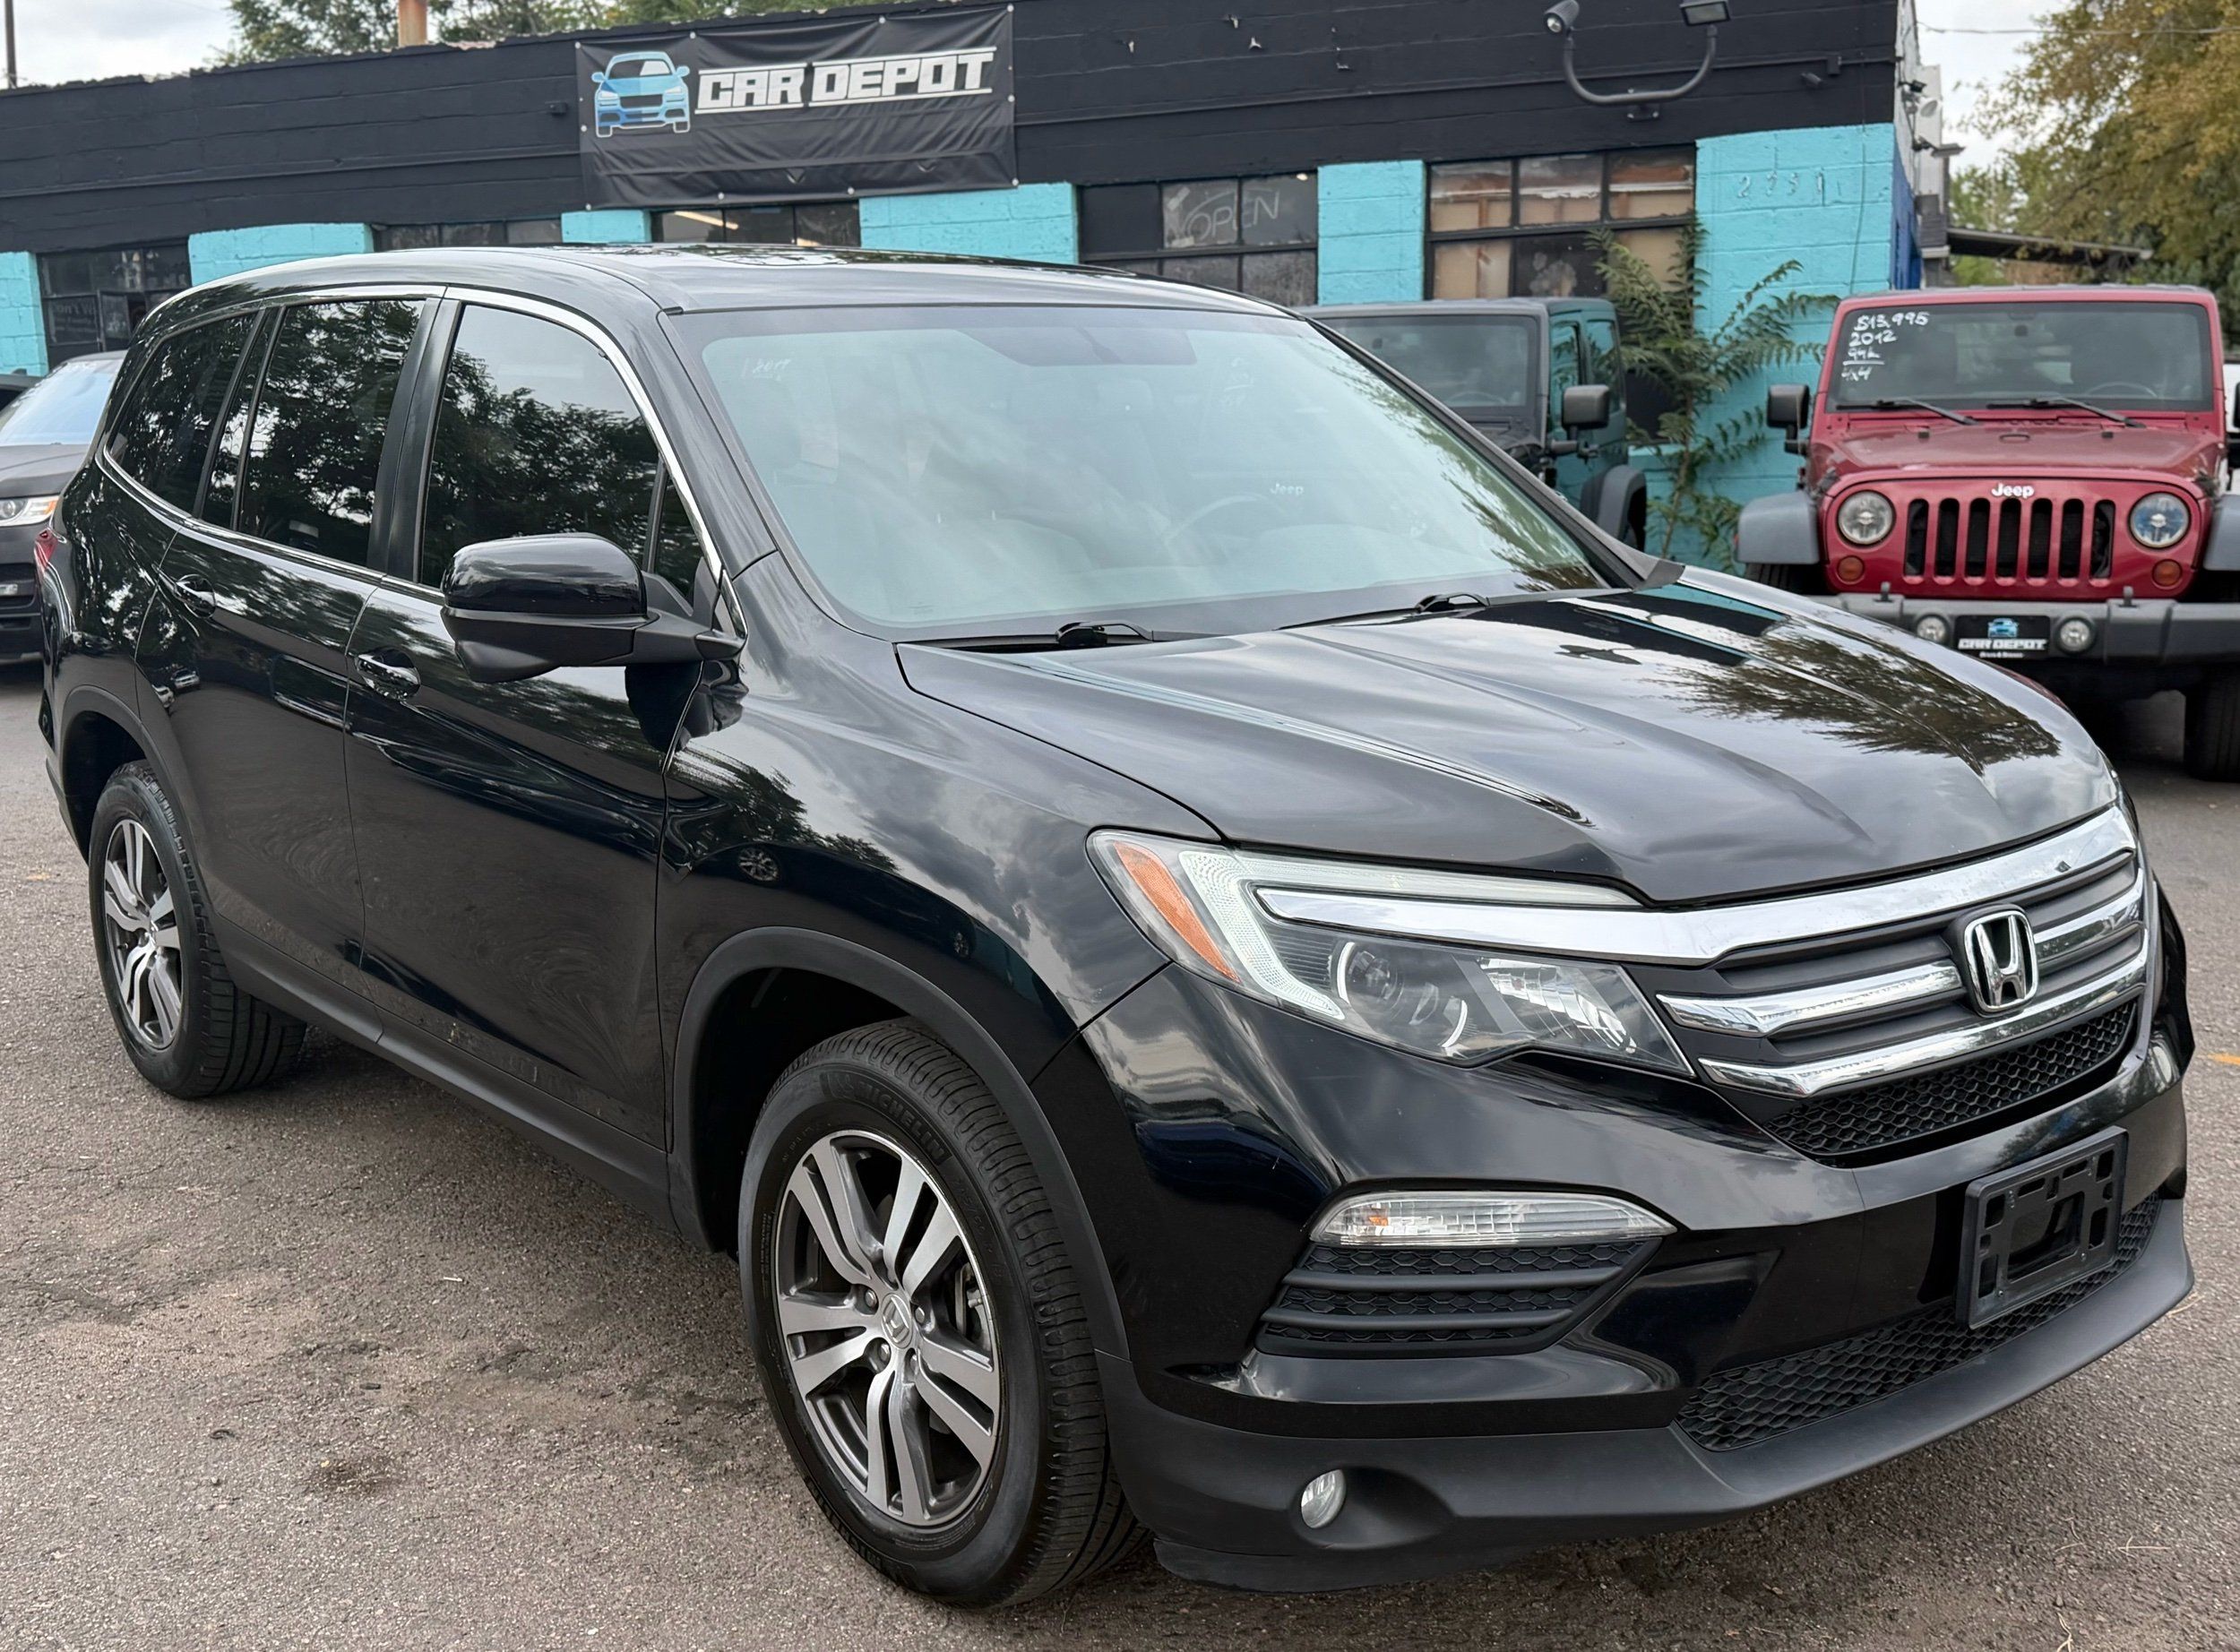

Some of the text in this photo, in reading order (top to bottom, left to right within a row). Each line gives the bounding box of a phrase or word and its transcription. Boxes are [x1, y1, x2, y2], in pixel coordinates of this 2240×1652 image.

[696, 51, 995, 111] CAR DEPOT
[1187, 190, 1280, 240] OPEN
[1848, 330, 1899, 347] 2012
[1991, 482, 2035, 499] Jeep
[1958, 638, 2048, 650] CAR DEPOT
[855, 1080, 945, 1160] MICHELIN
